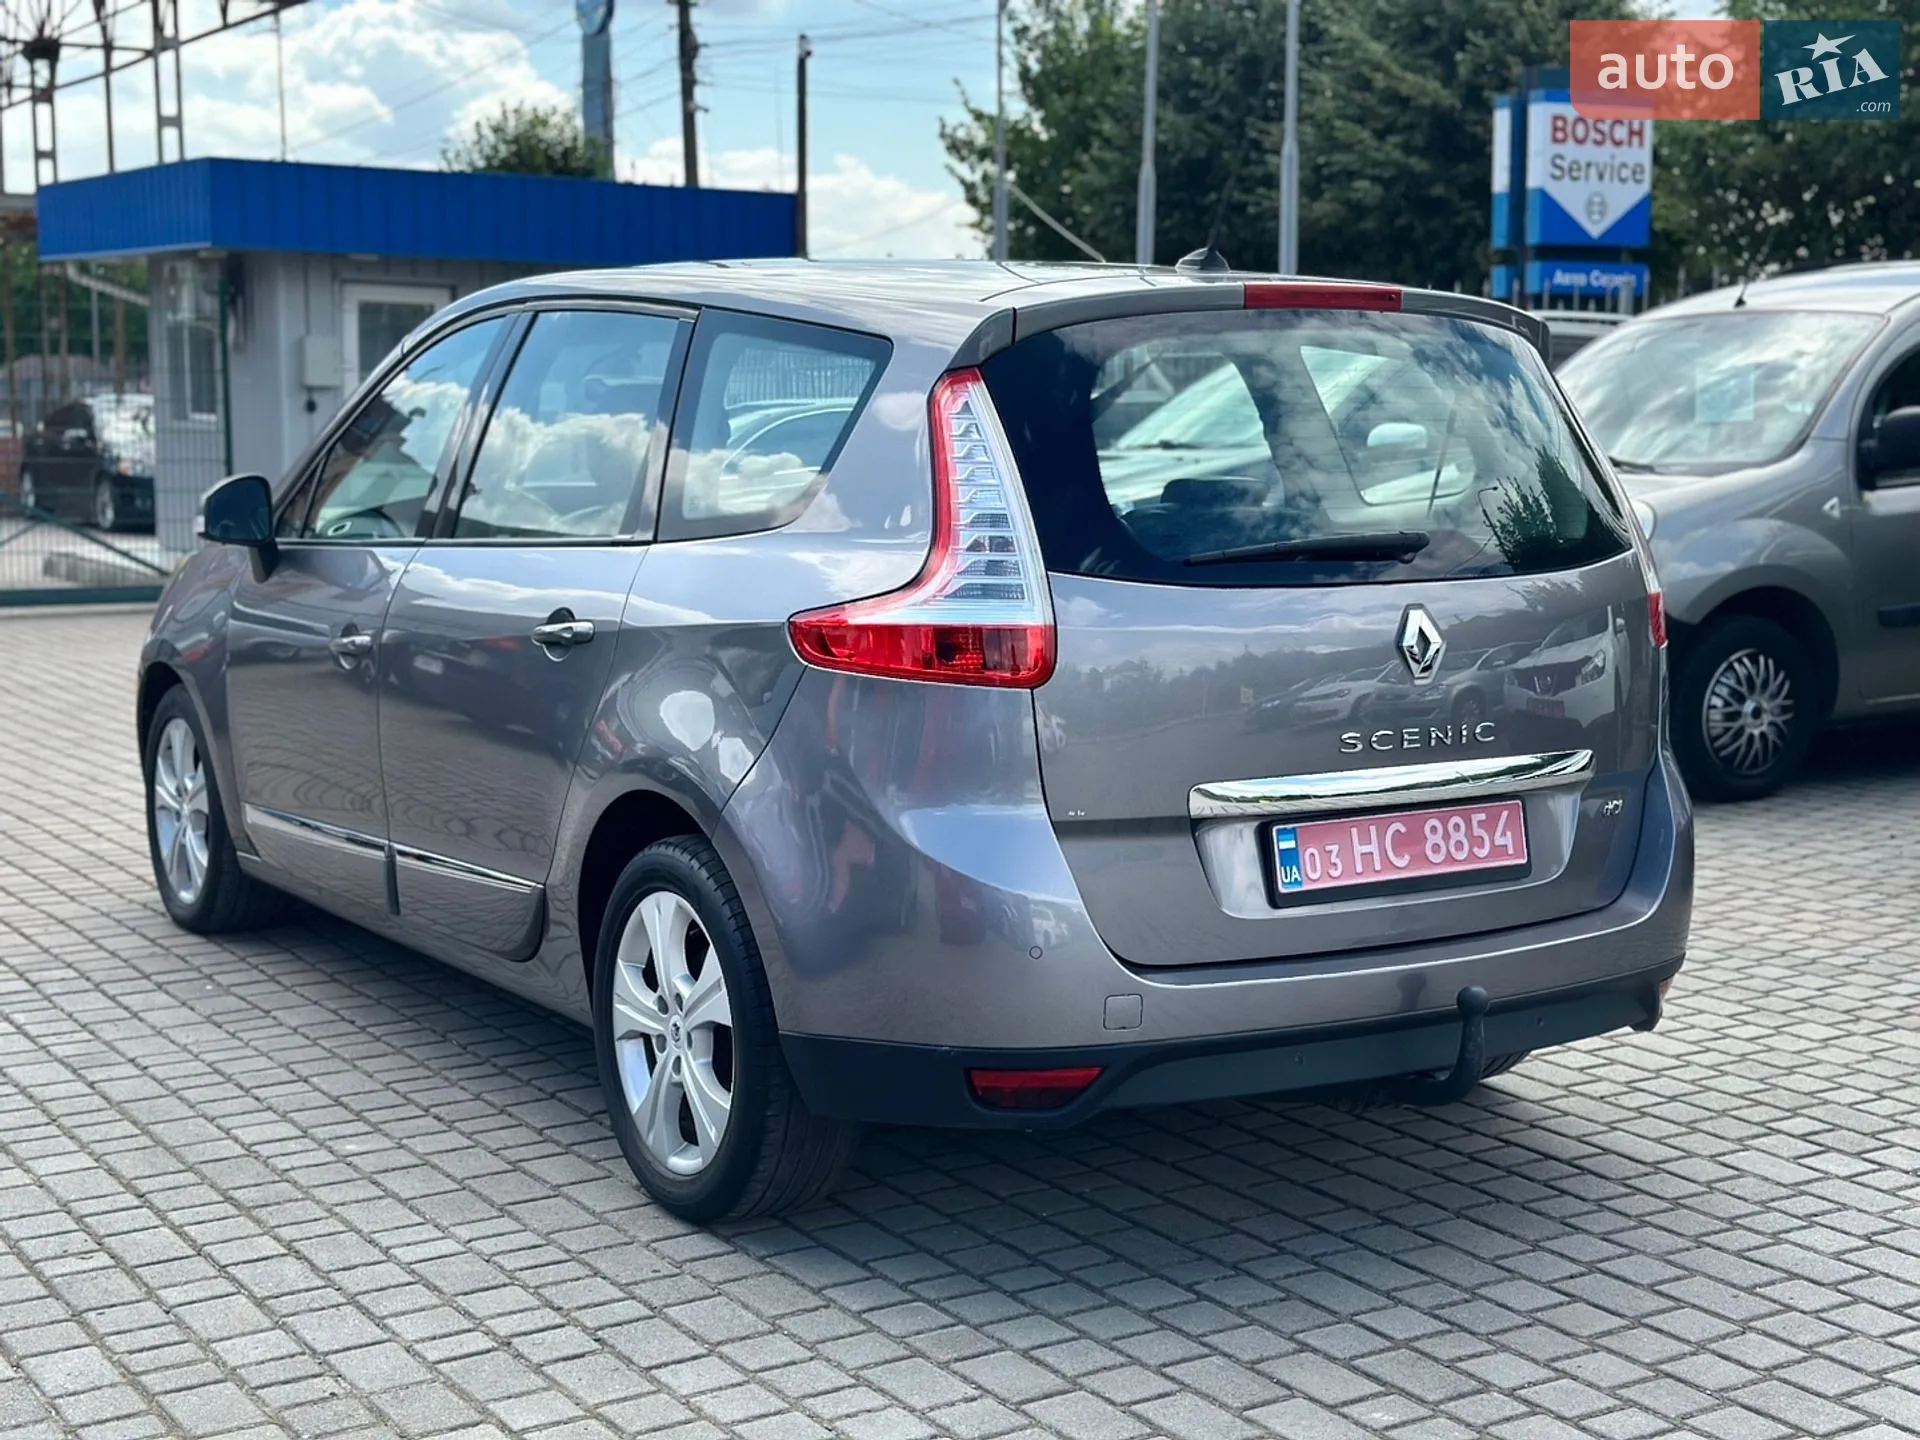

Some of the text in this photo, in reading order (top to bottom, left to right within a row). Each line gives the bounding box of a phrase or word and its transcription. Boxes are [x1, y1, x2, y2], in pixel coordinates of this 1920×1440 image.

[1551, 115, 1645, 149] BOSCH
[1549, 153, 1645, 184] Service
[1340, 722, 1495, 753] SCENIC
[1304, 810, 1515, 881] 03 HC 8854
[1281, 866, 1301, 883] UA
